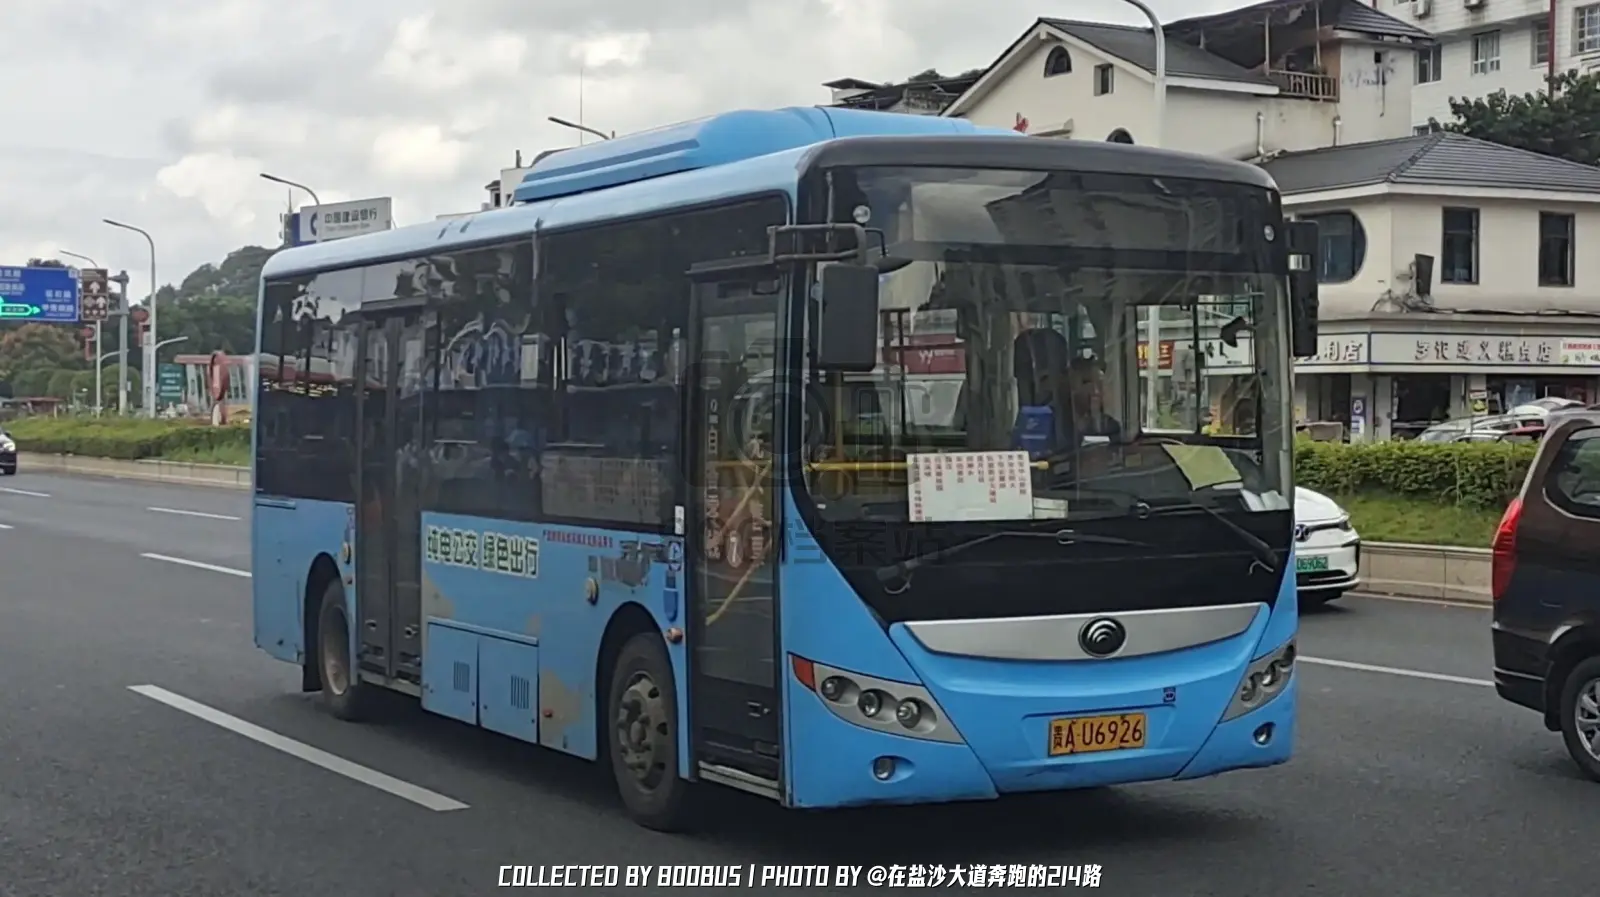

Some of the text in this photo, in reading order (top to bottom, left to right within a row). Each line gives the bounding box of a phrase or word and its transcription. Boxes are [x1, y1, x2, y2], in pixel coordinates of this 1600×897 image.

[324, 206, 378, 224] 中国建设银行
